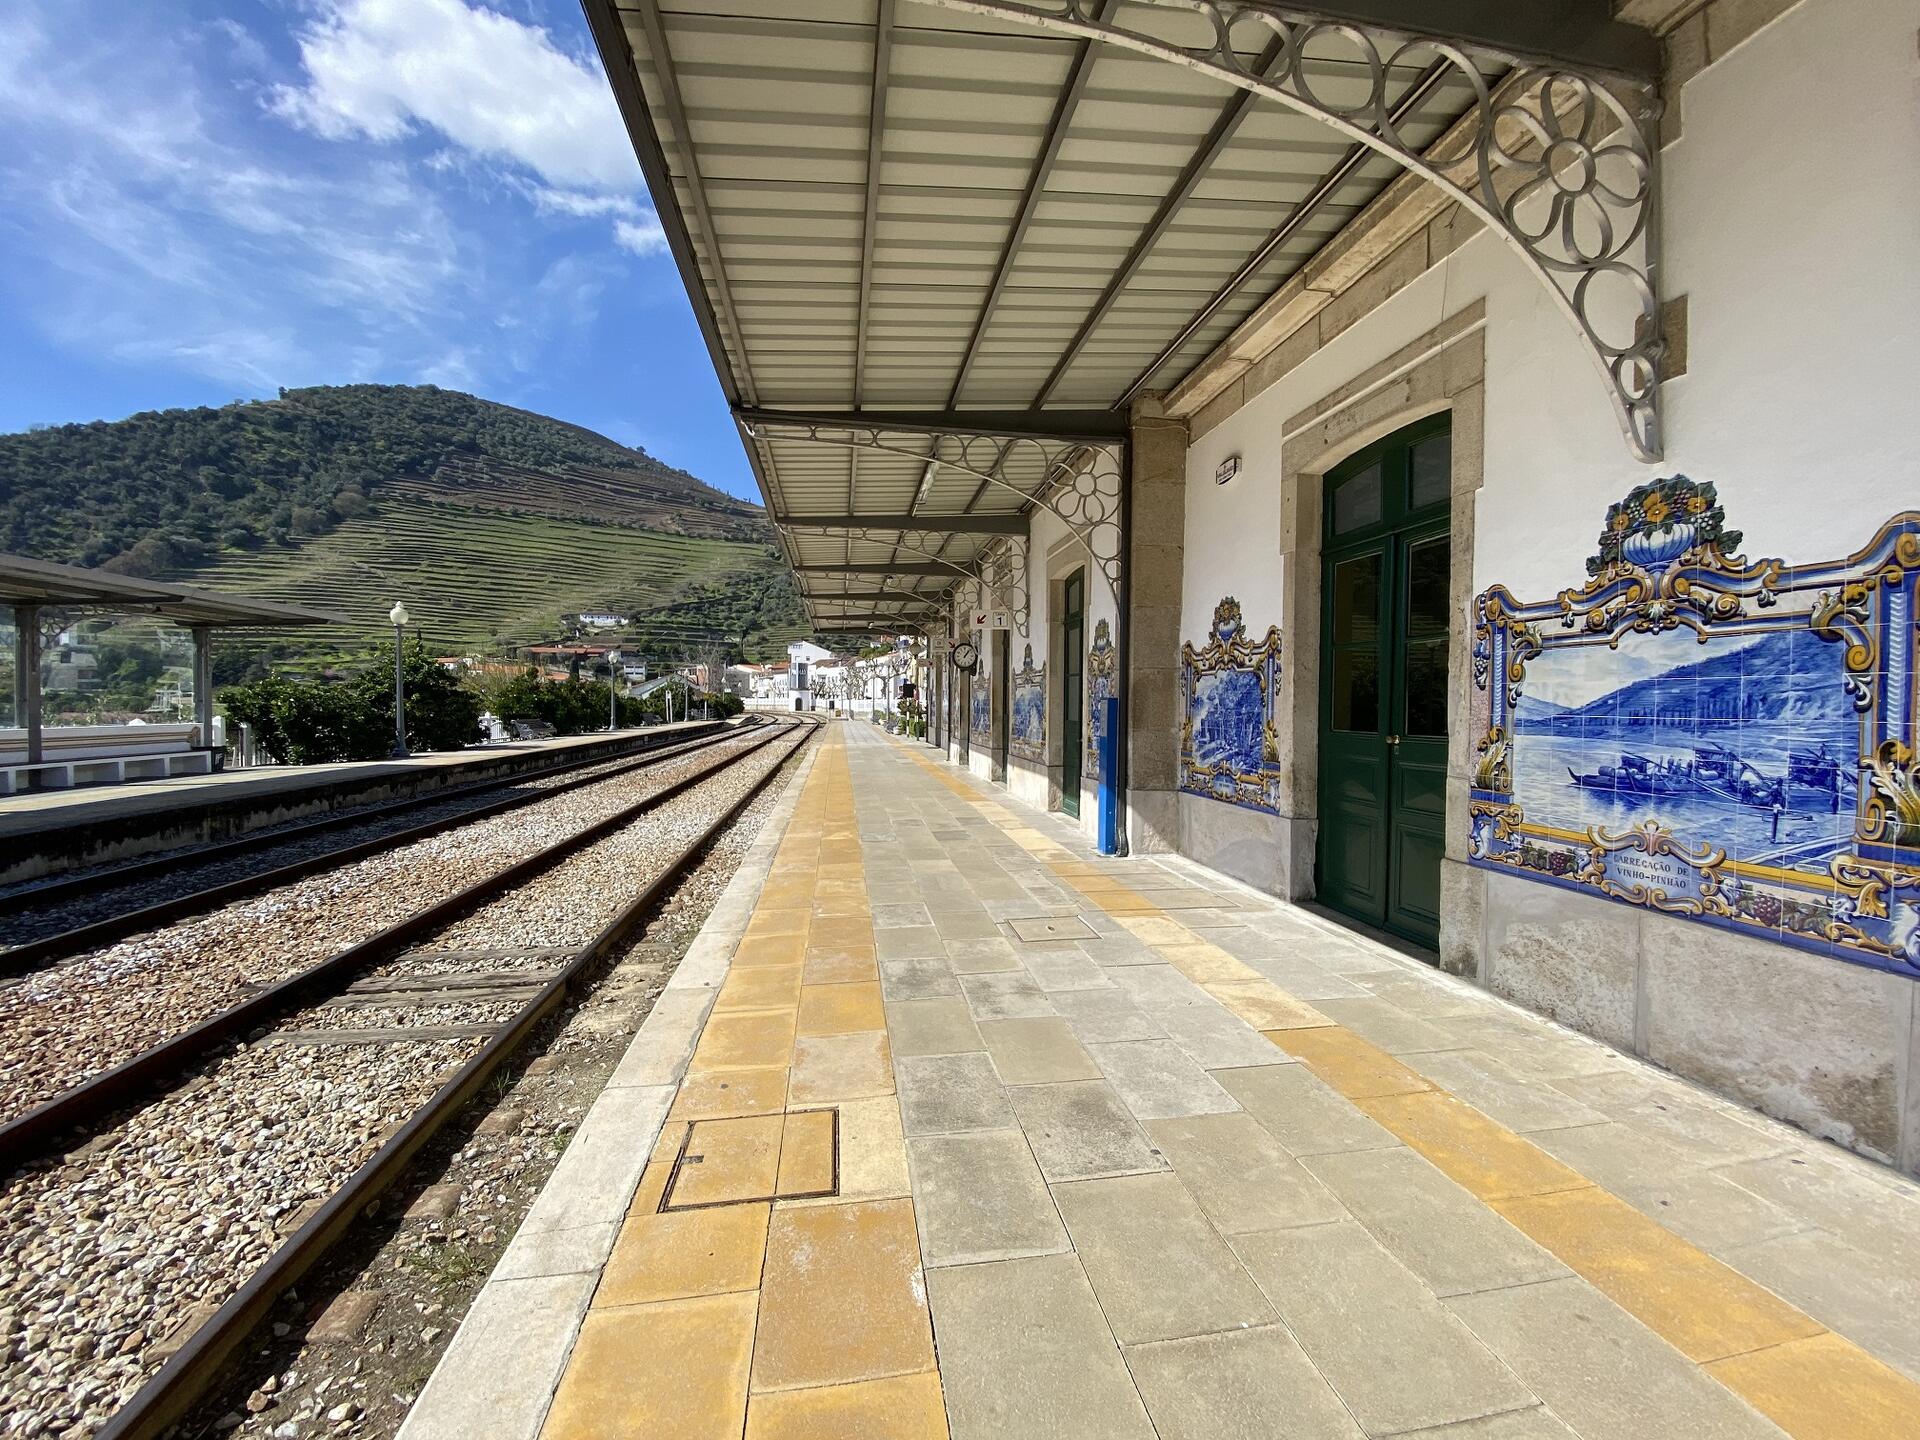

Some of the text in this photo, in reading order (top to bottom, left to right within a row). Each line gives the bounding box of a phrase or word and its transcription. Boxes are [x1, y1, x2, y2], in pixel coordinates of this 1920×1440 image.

[997, 616, 1002, 626] 1
[1614, 855, 1688, 876] CARREGAÇÃO DE
[1617, 867, 1686, 888] VINHO-PINHÃO
